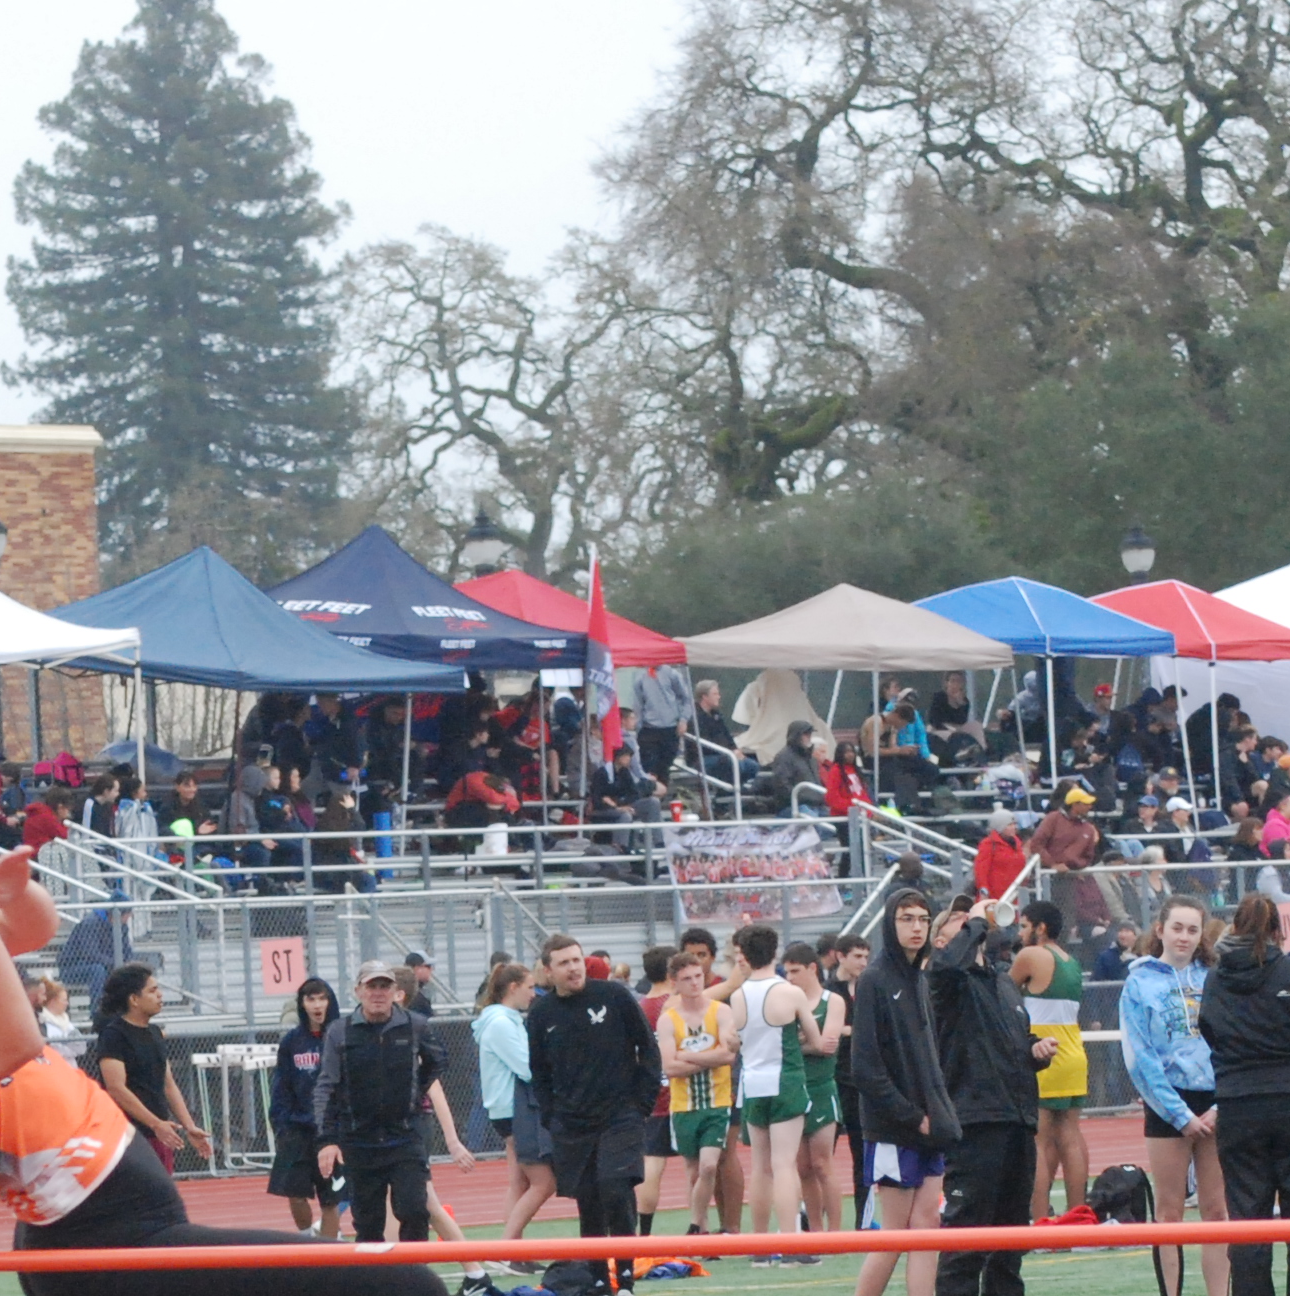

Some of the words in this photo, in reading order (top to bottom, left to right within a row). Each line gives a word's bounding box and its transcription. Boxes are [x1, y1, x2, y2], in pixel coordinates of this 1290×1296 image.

[317, 600, 372, 615] FEET
[411, 605, 455, 618] FLEET
[271, 950, 292, 984] ST
